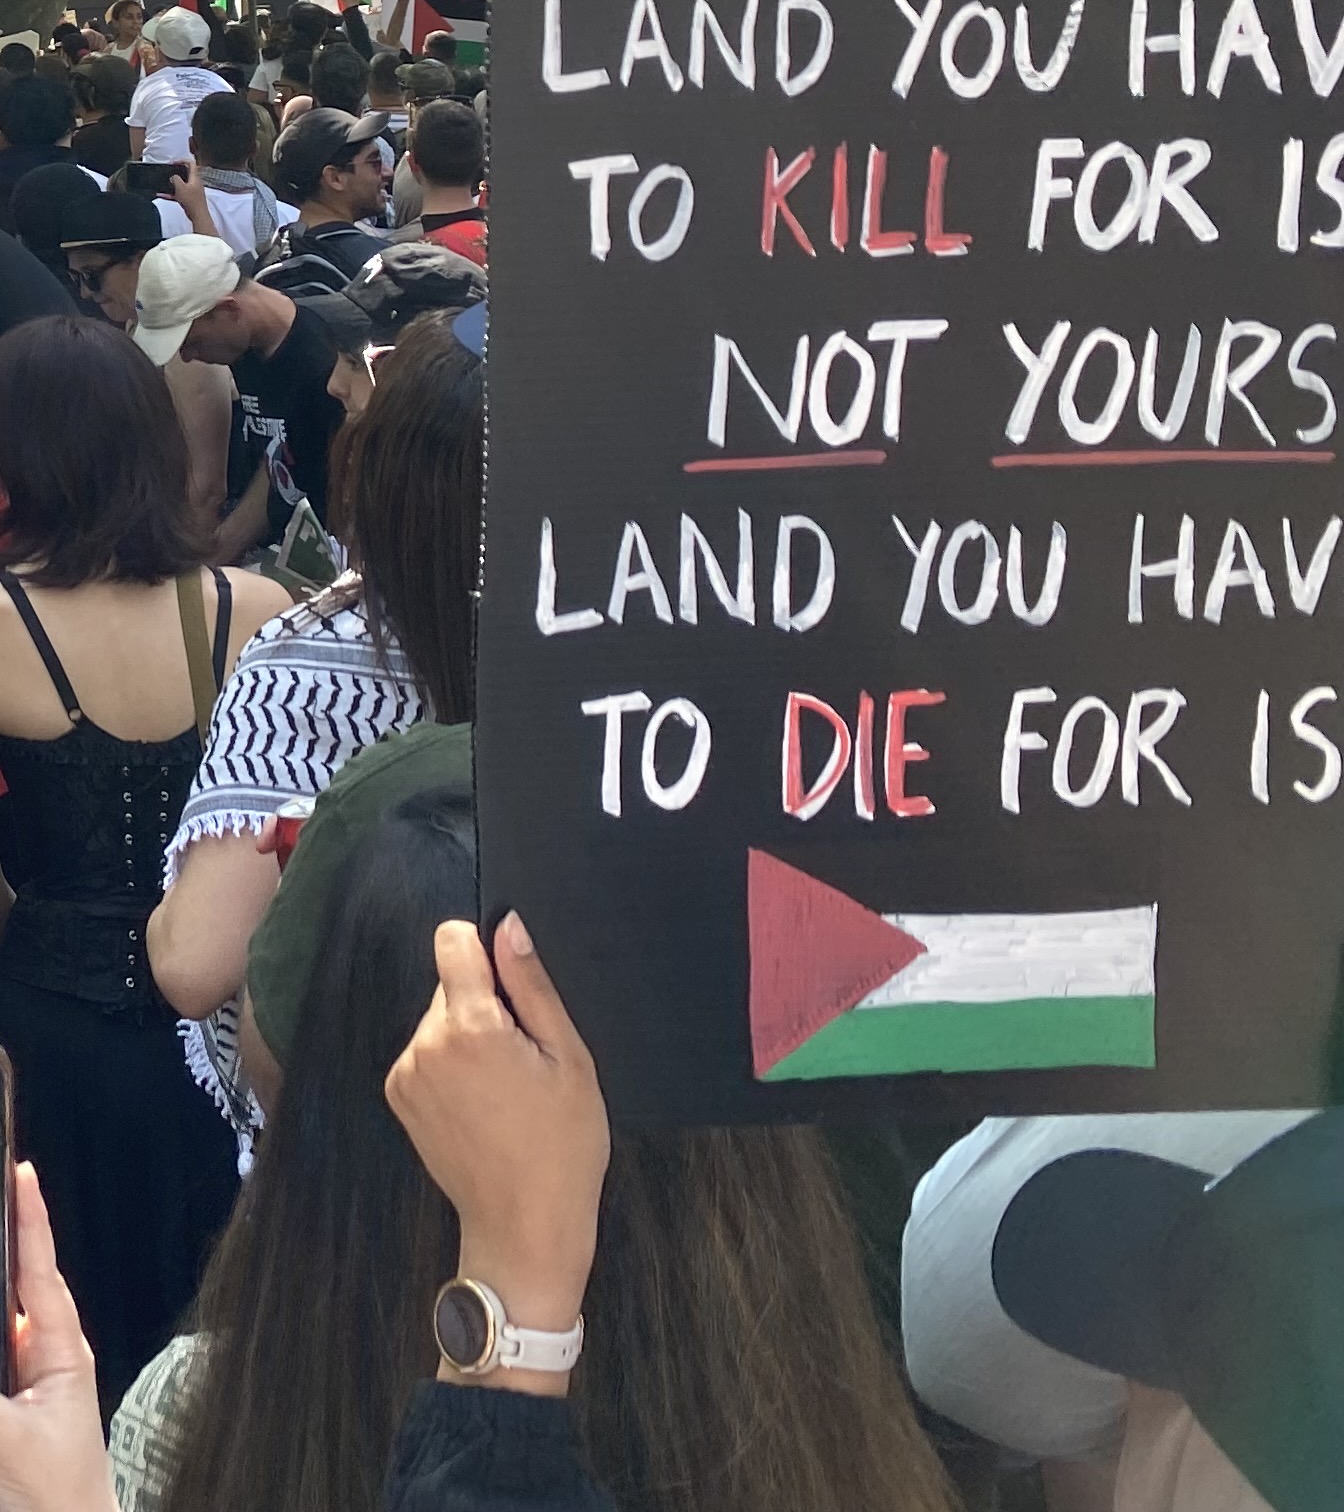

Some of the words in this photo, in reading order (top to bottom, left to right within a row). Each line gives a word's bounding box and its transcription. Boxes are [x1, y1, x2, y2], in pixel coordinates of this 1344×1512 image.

[567, 153, 695, 263] TO
[760, 141, 973, 259] KILL
[1027, 136, 1220, 253] FOR
[1276, 131, 1344, 255] IS
[706, 318, 950, 449] NOT
[1002, 317, 1338, 448] YOURS
[534, 505, 836, 636] LAND
[891, 513, 1068, 635] YOU
[580, 689, 712, 819] TO
[781, 687, 947, 822] DIE
[1000, 685, 1193, 815] FOR
[1249, 685, 1342, 806] IS
